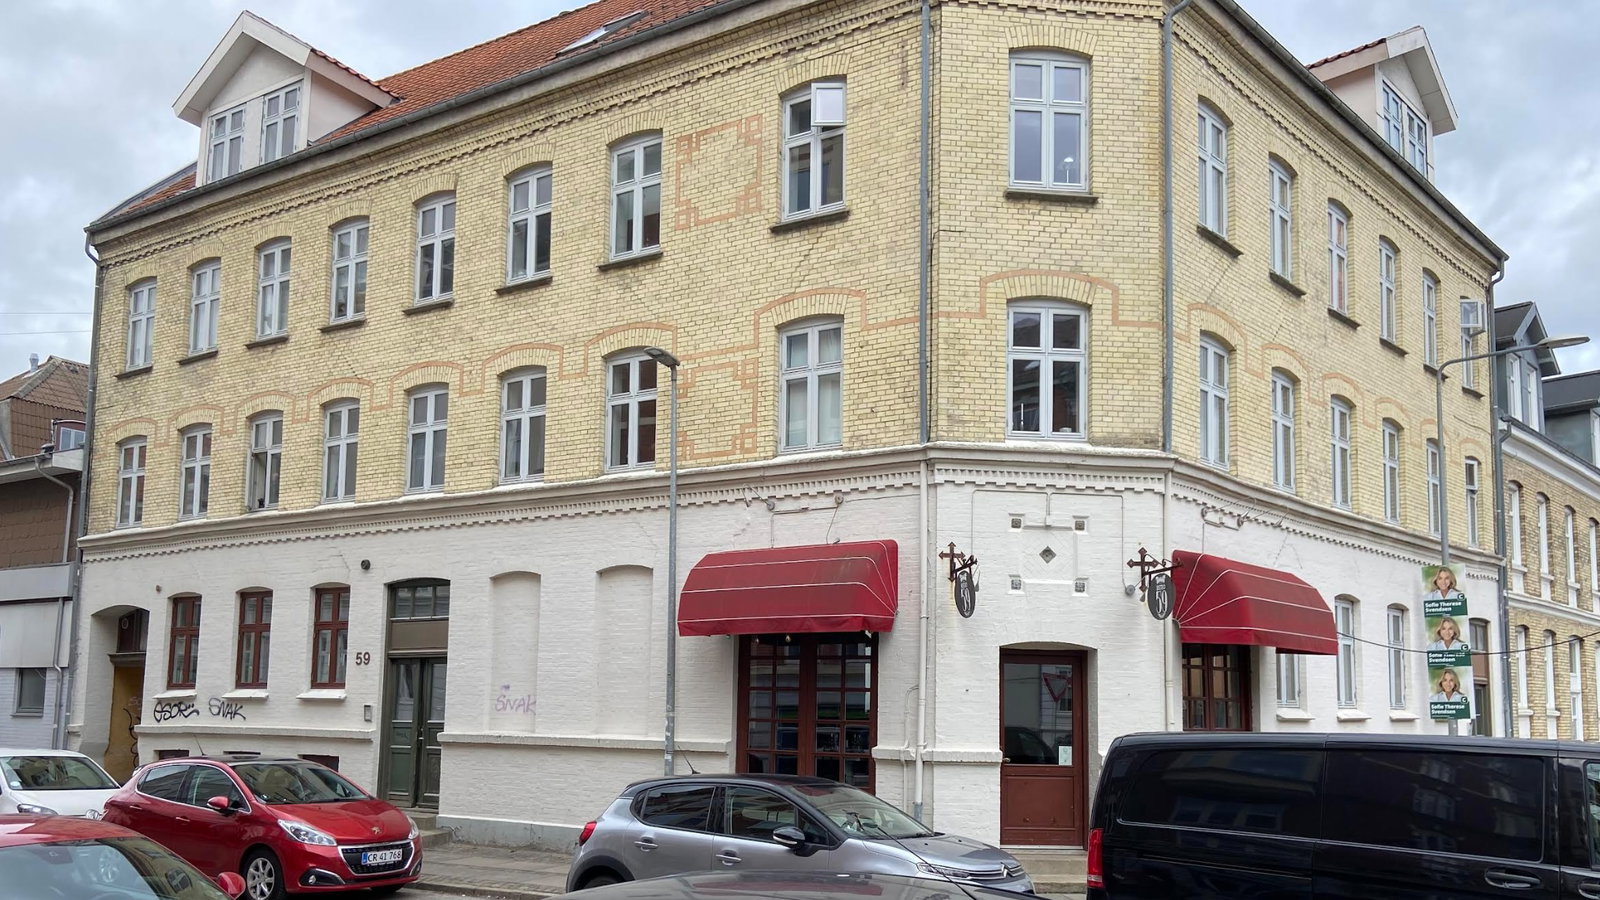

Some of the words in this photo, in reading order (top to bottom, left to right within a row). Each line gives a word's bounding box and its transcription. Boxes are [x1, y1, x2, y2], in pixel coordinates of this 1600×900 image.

[960, 587, 971, 616] 59
[1155, 590, 1168, 618] 59
[355, 652, 371, 666] 59
[208, 697, 247, 720] SNAK
[494, 694, 537, 716] SNAK
[367, 853, 378, 863] CR
[380, 852, 387, 861] 41
[389, 850, 402, 860] 768
